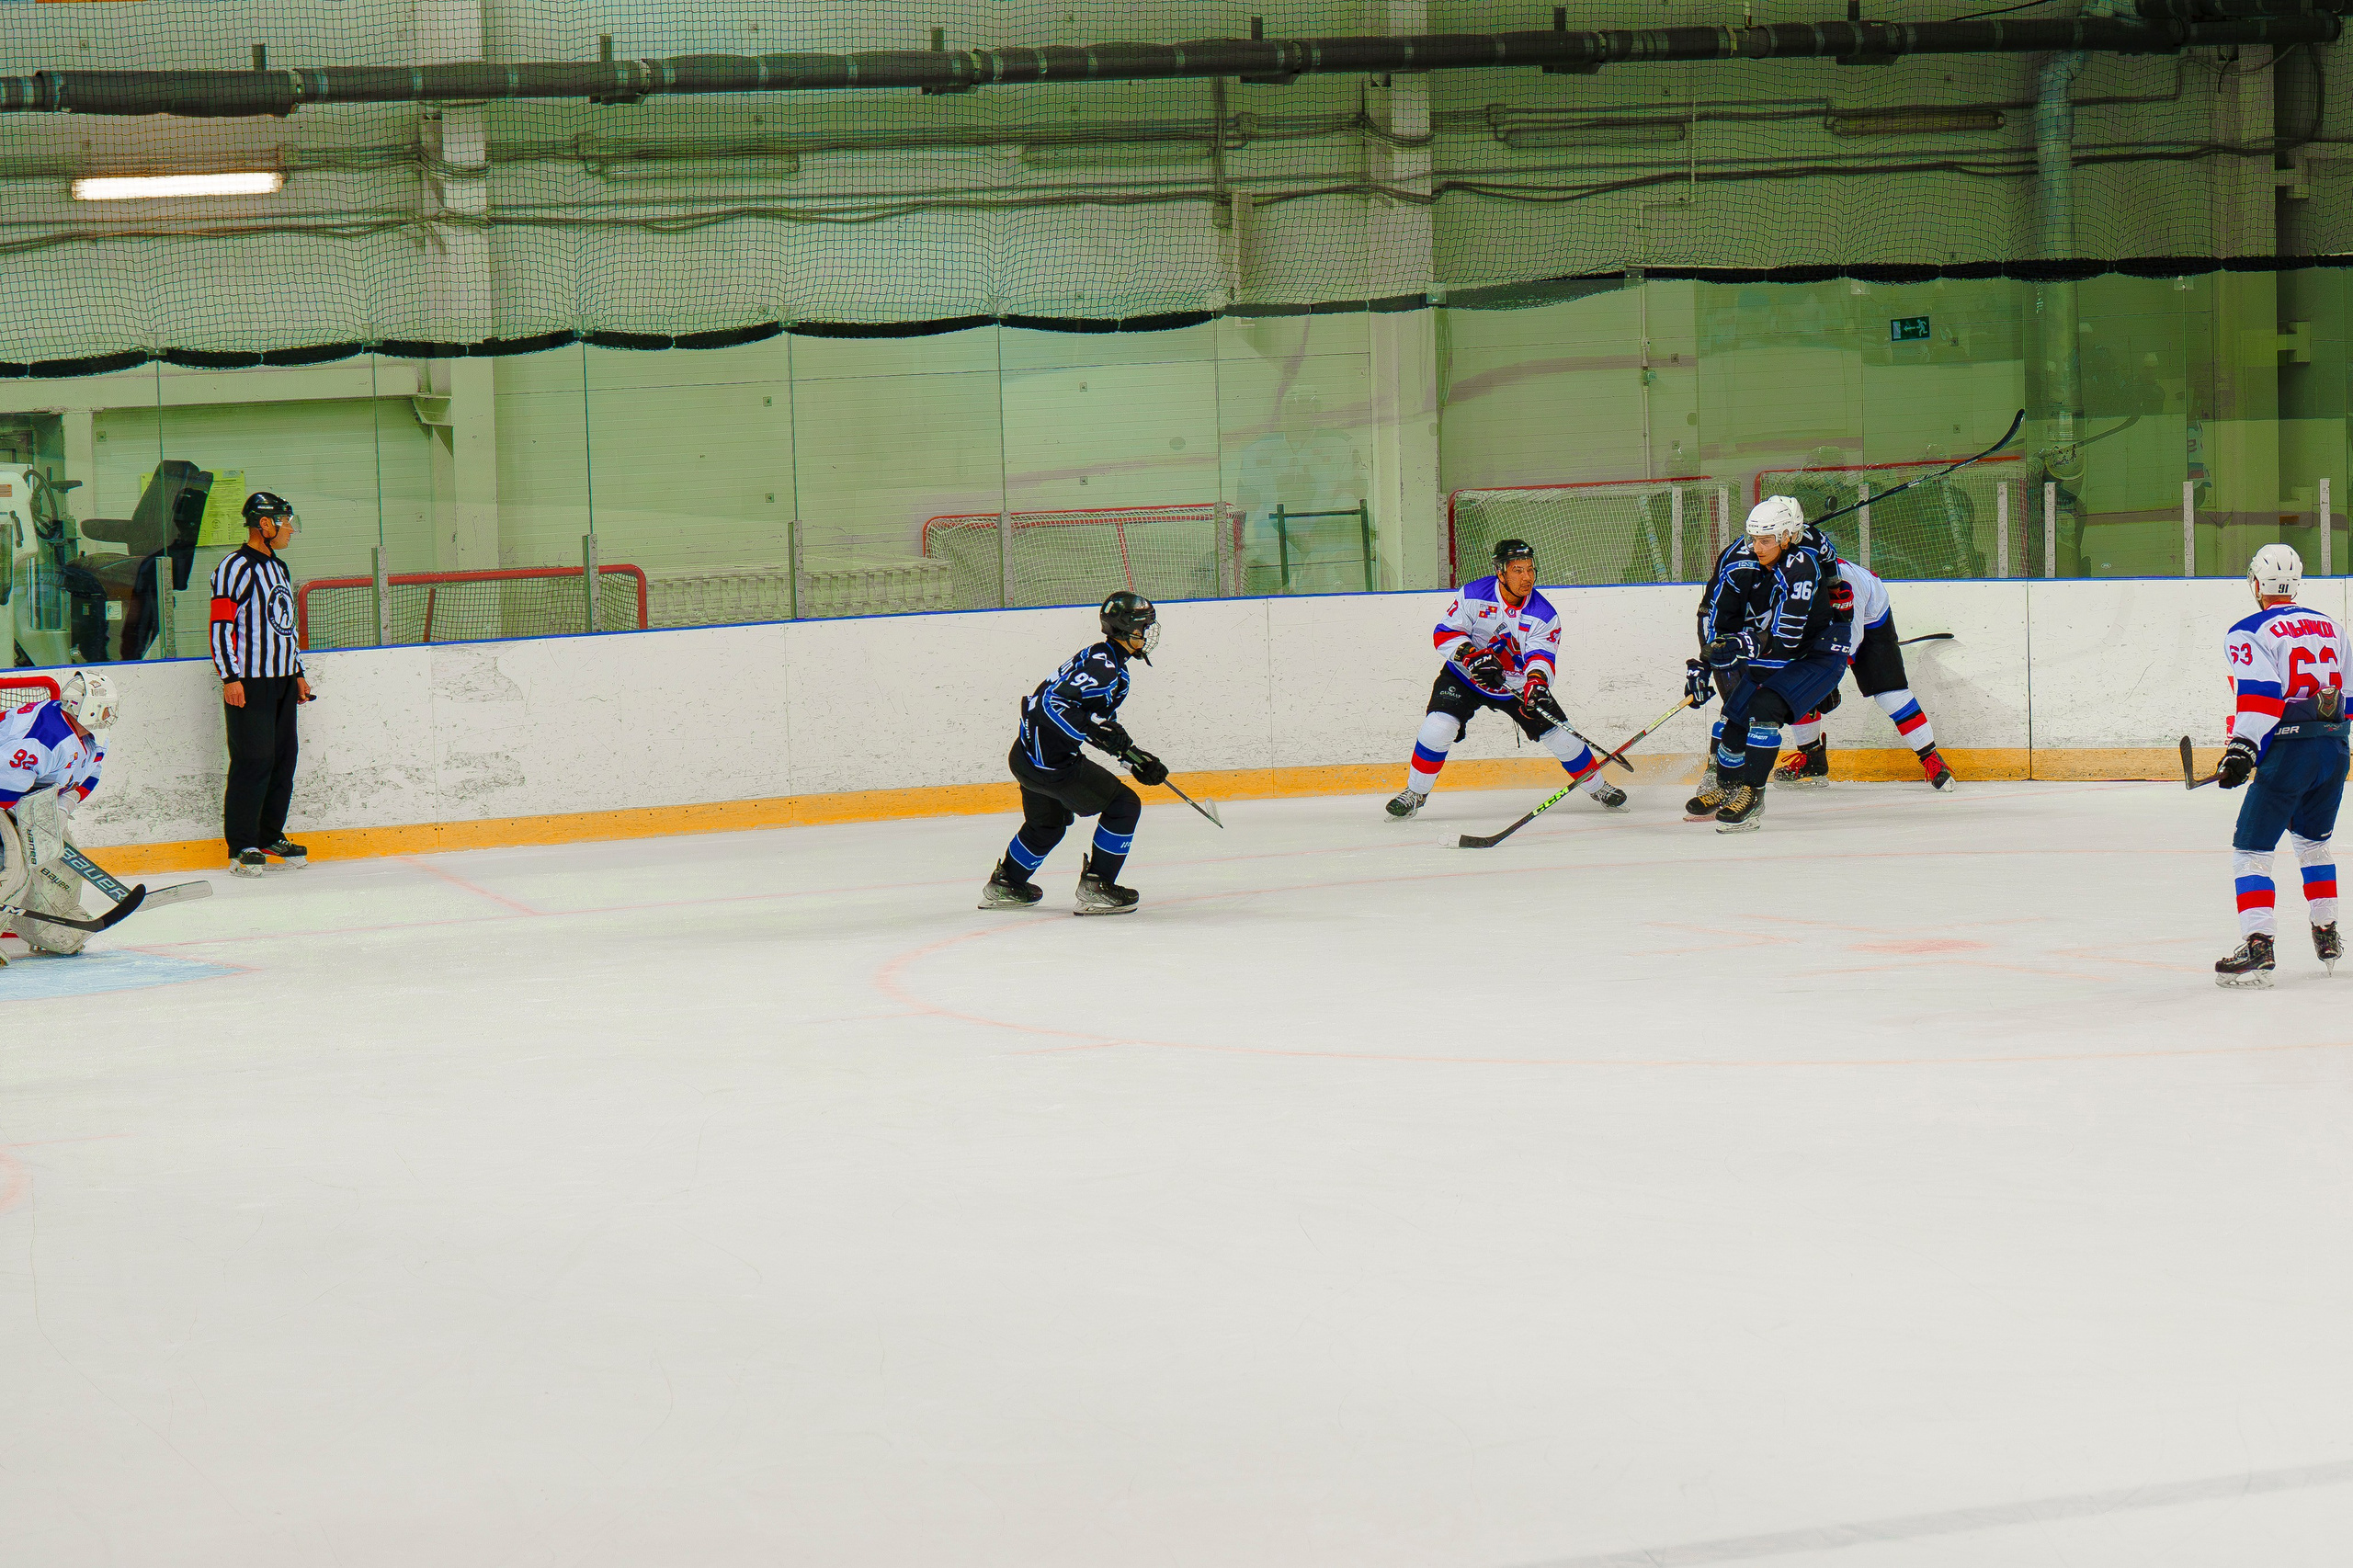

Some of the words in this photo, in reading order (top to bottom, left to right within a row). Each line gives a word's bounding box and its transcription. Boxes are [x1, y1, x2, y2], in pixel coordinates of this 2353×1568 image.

[1790, 581, 1813, 601] 96
[2278, 583, 2290, 594] 91
[1830, 643, 1851, 653] CC
[1468, 653, 1493, 672] CCM
[2282, 645, 2343, 699] 63
[1070, 672, 1098, 691] 97
[9, 748, 39, 770] 92
[1532, 786, 1570, 816] CCM
[27, 828, 38, 866] BAUER
[40, 867, 71, 892] BAUER
[62, 846, 130, 902] BAUER
[1, 904, 27, 916] M
